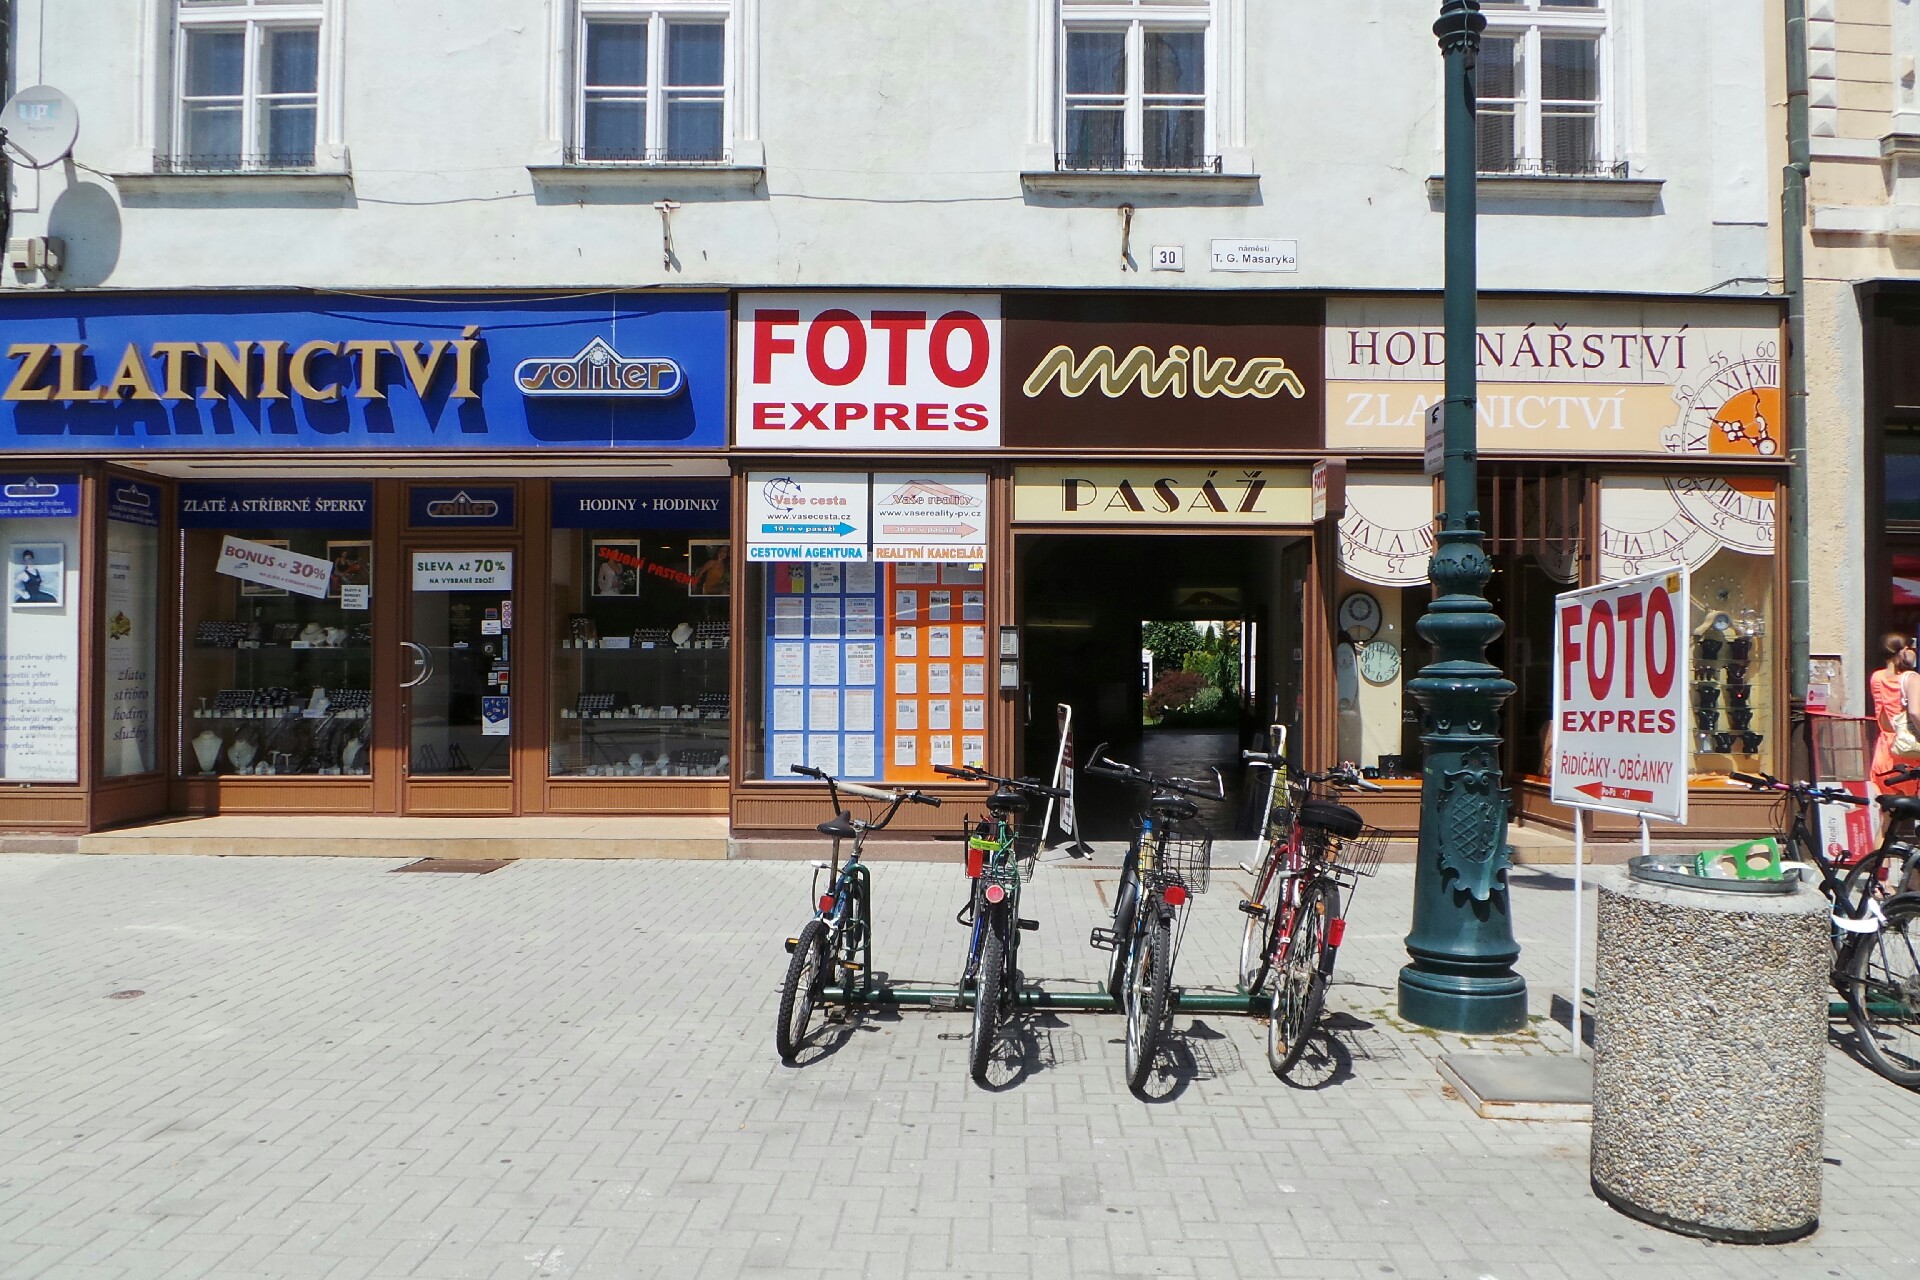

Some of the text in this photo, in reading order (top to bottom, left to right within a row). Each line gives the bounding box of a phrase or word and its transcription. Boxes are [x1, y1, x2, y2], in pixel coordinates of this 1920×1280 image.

[1159, 251, 1176, 264] 30
[1213, 253, 1295, 266] T. G. Masaryka
[752, 308, 990, 389] FOTO
[1347, 323, 1688, 370] HODNÁŘSTVÍ
[1757, 341, 1776, 358] 60
[2, 326, 482, 402] ZLATNICTVÍ
[1709, 350, 1729, 370] 55
[752, 402, 989, 432] EXPRES
[1345, 389, 1626, 430] ZLANICTVÍ
[1064, 470, 1268, 514] PASÁŽ
[184, 497, 367, 512] ZLATÉ A STŘÍBRNÉ ŠPERKY
[579, 499, 719, 511] HODINY HODINKY
[774, 495, 847, 506] Vaše cesta
[893, 494, 973, 507] Vaše reality
[767, 513, 851, 521] www.vasecesta.cz
[878, 510, 982, 518] www.vasereality-pv.cz
[750, 545, 863, 559] CESTOVNÍ AGENTURA
[876, 545, 984, 559] REALITNÍ KANCELÁŘ
[225, 545, 275, 567] BONUS
[289, 560, 326, 580] 30%
[417, 562, 453, 571] SLEVA
[459, 562, 470, 571] AŽ
[1561, 586, 1676, 701] FOTO
[118, 667, 146, 681] zlato
[113, 706, 149, 722] hodiny
[1562, 709, 1676, 734] EXPRES
[1560, 751, 1610, 778] ŘIDIČÁKY
[1618, 753, 1673, 784] OBČANKY
